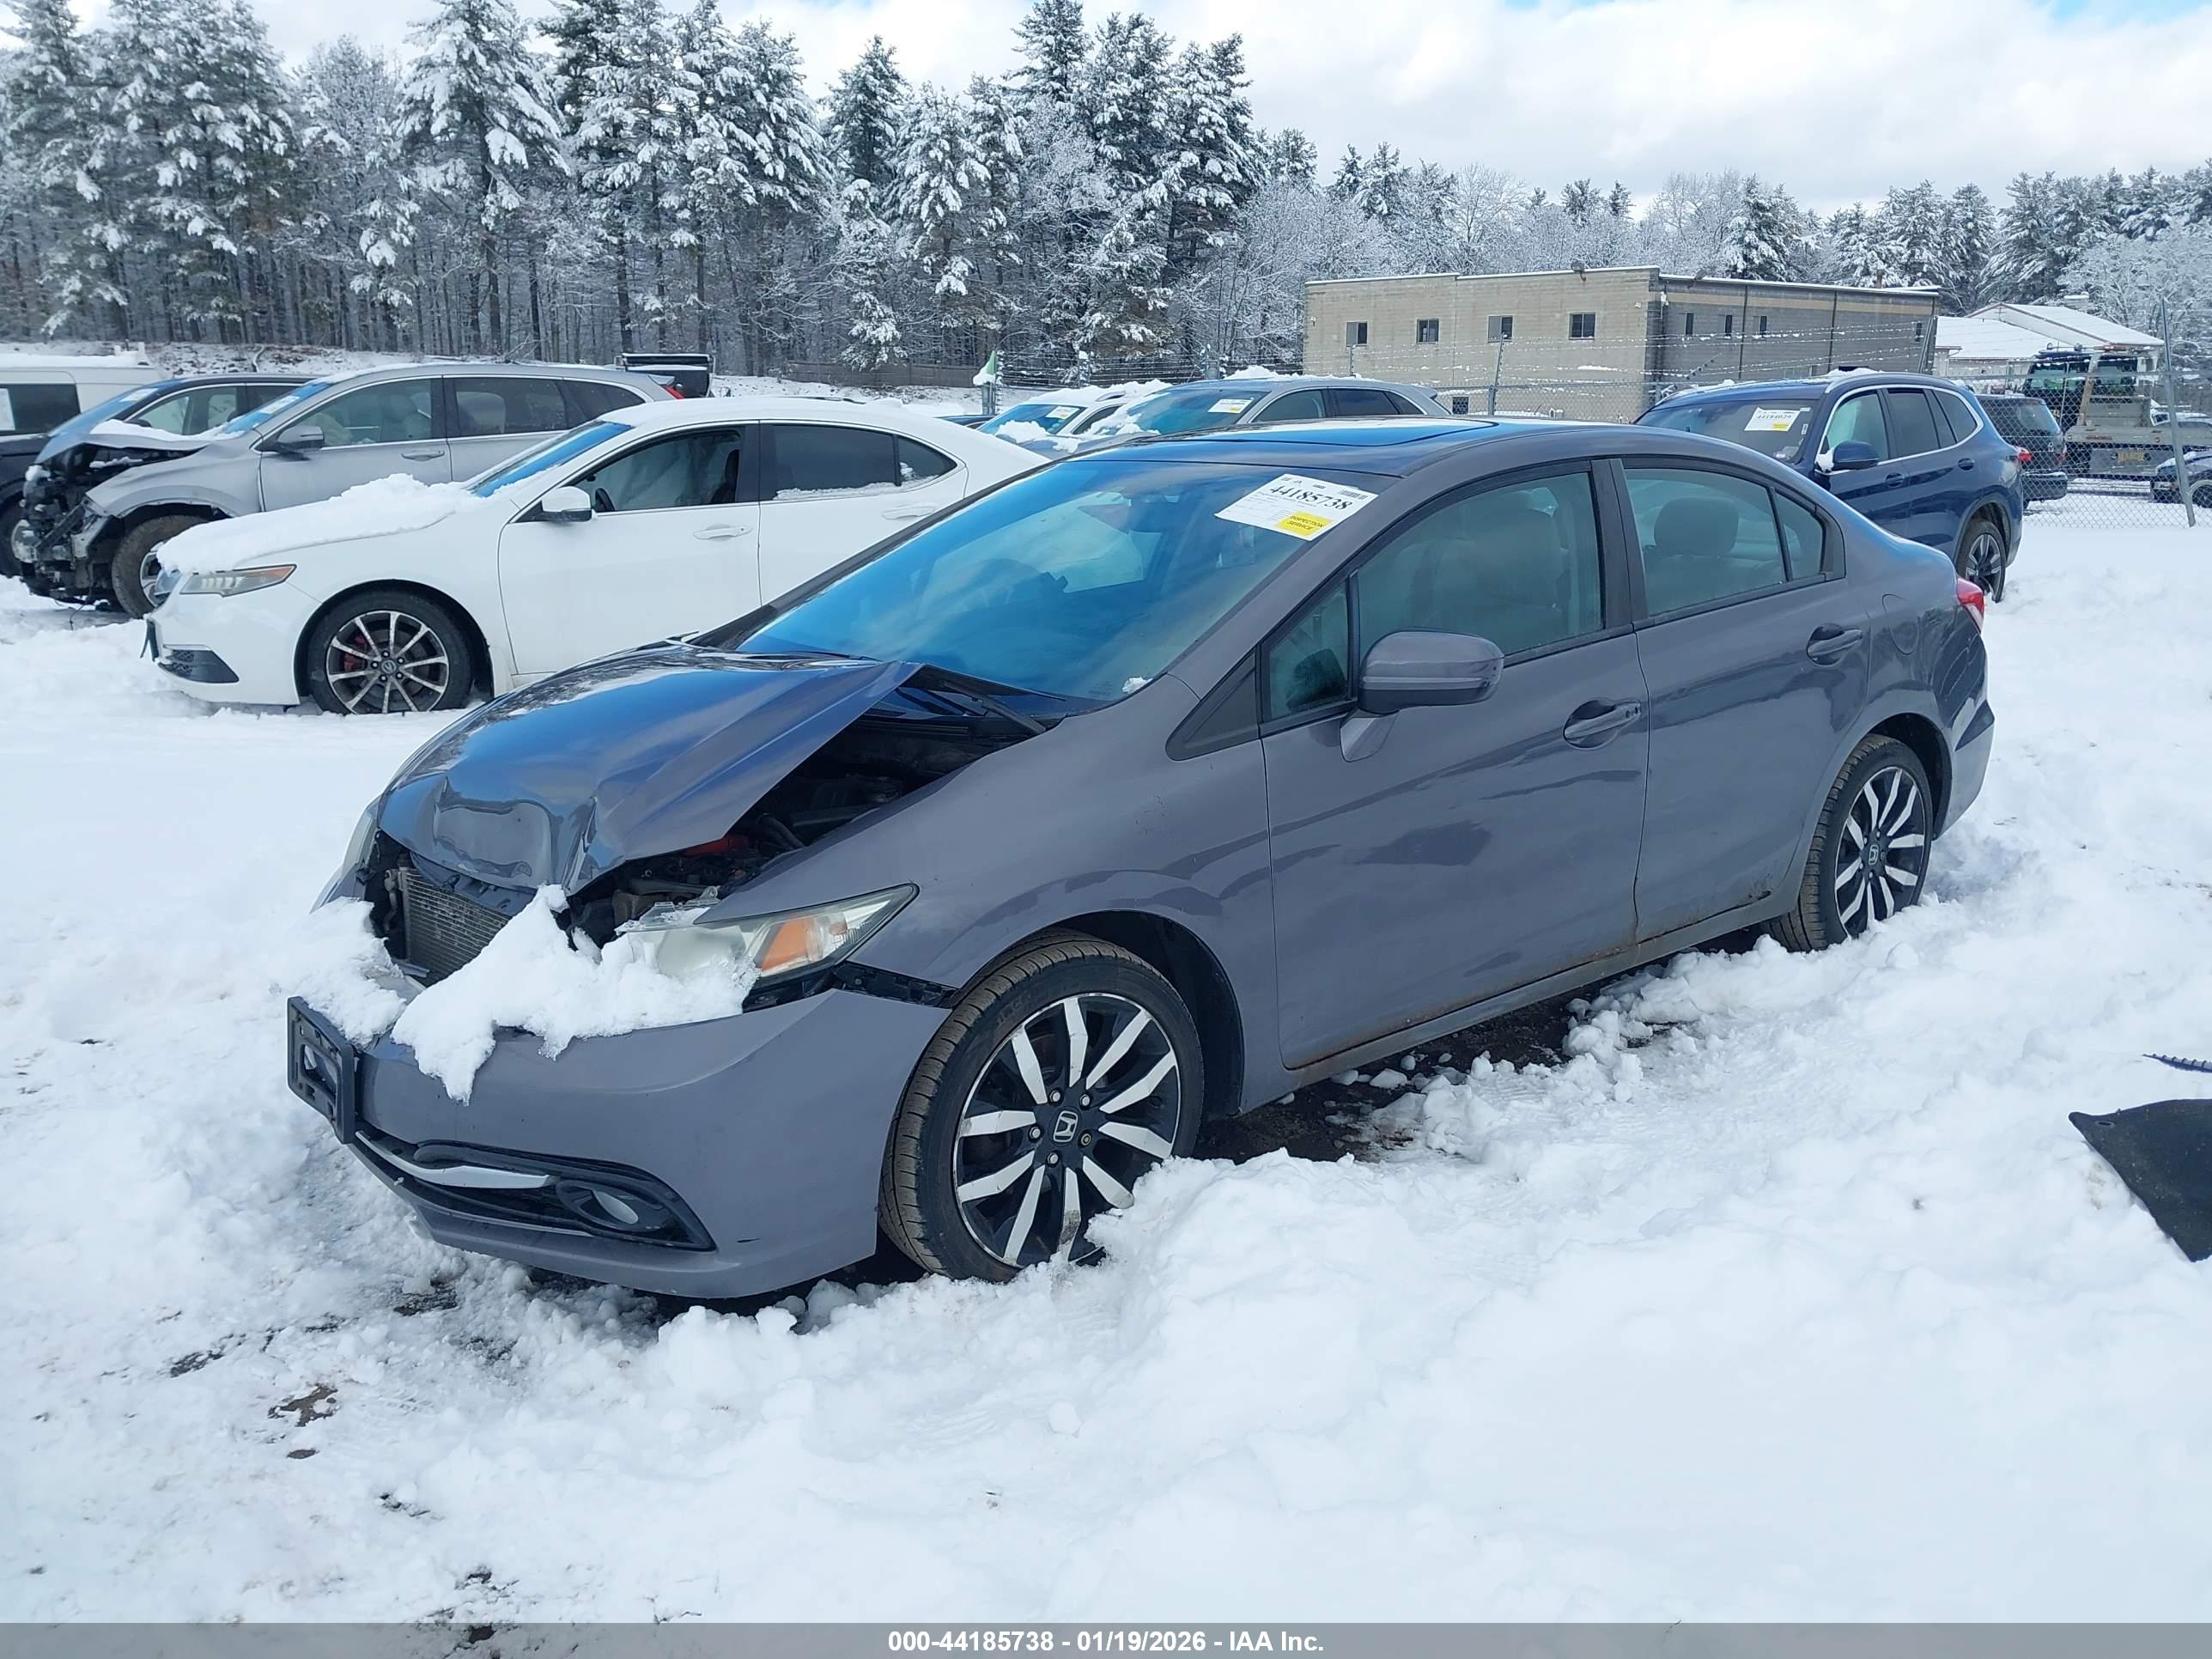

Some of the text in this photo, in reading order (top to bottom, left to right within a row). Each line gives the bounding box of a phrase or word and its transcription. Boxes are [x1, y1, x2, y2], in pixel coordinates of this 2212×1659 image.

[1270, 485, 1353, 510] 44185738
[1287, 520, 1315, 531] SERVICE
[1290, 515, 1325, 528] INSPECTION
